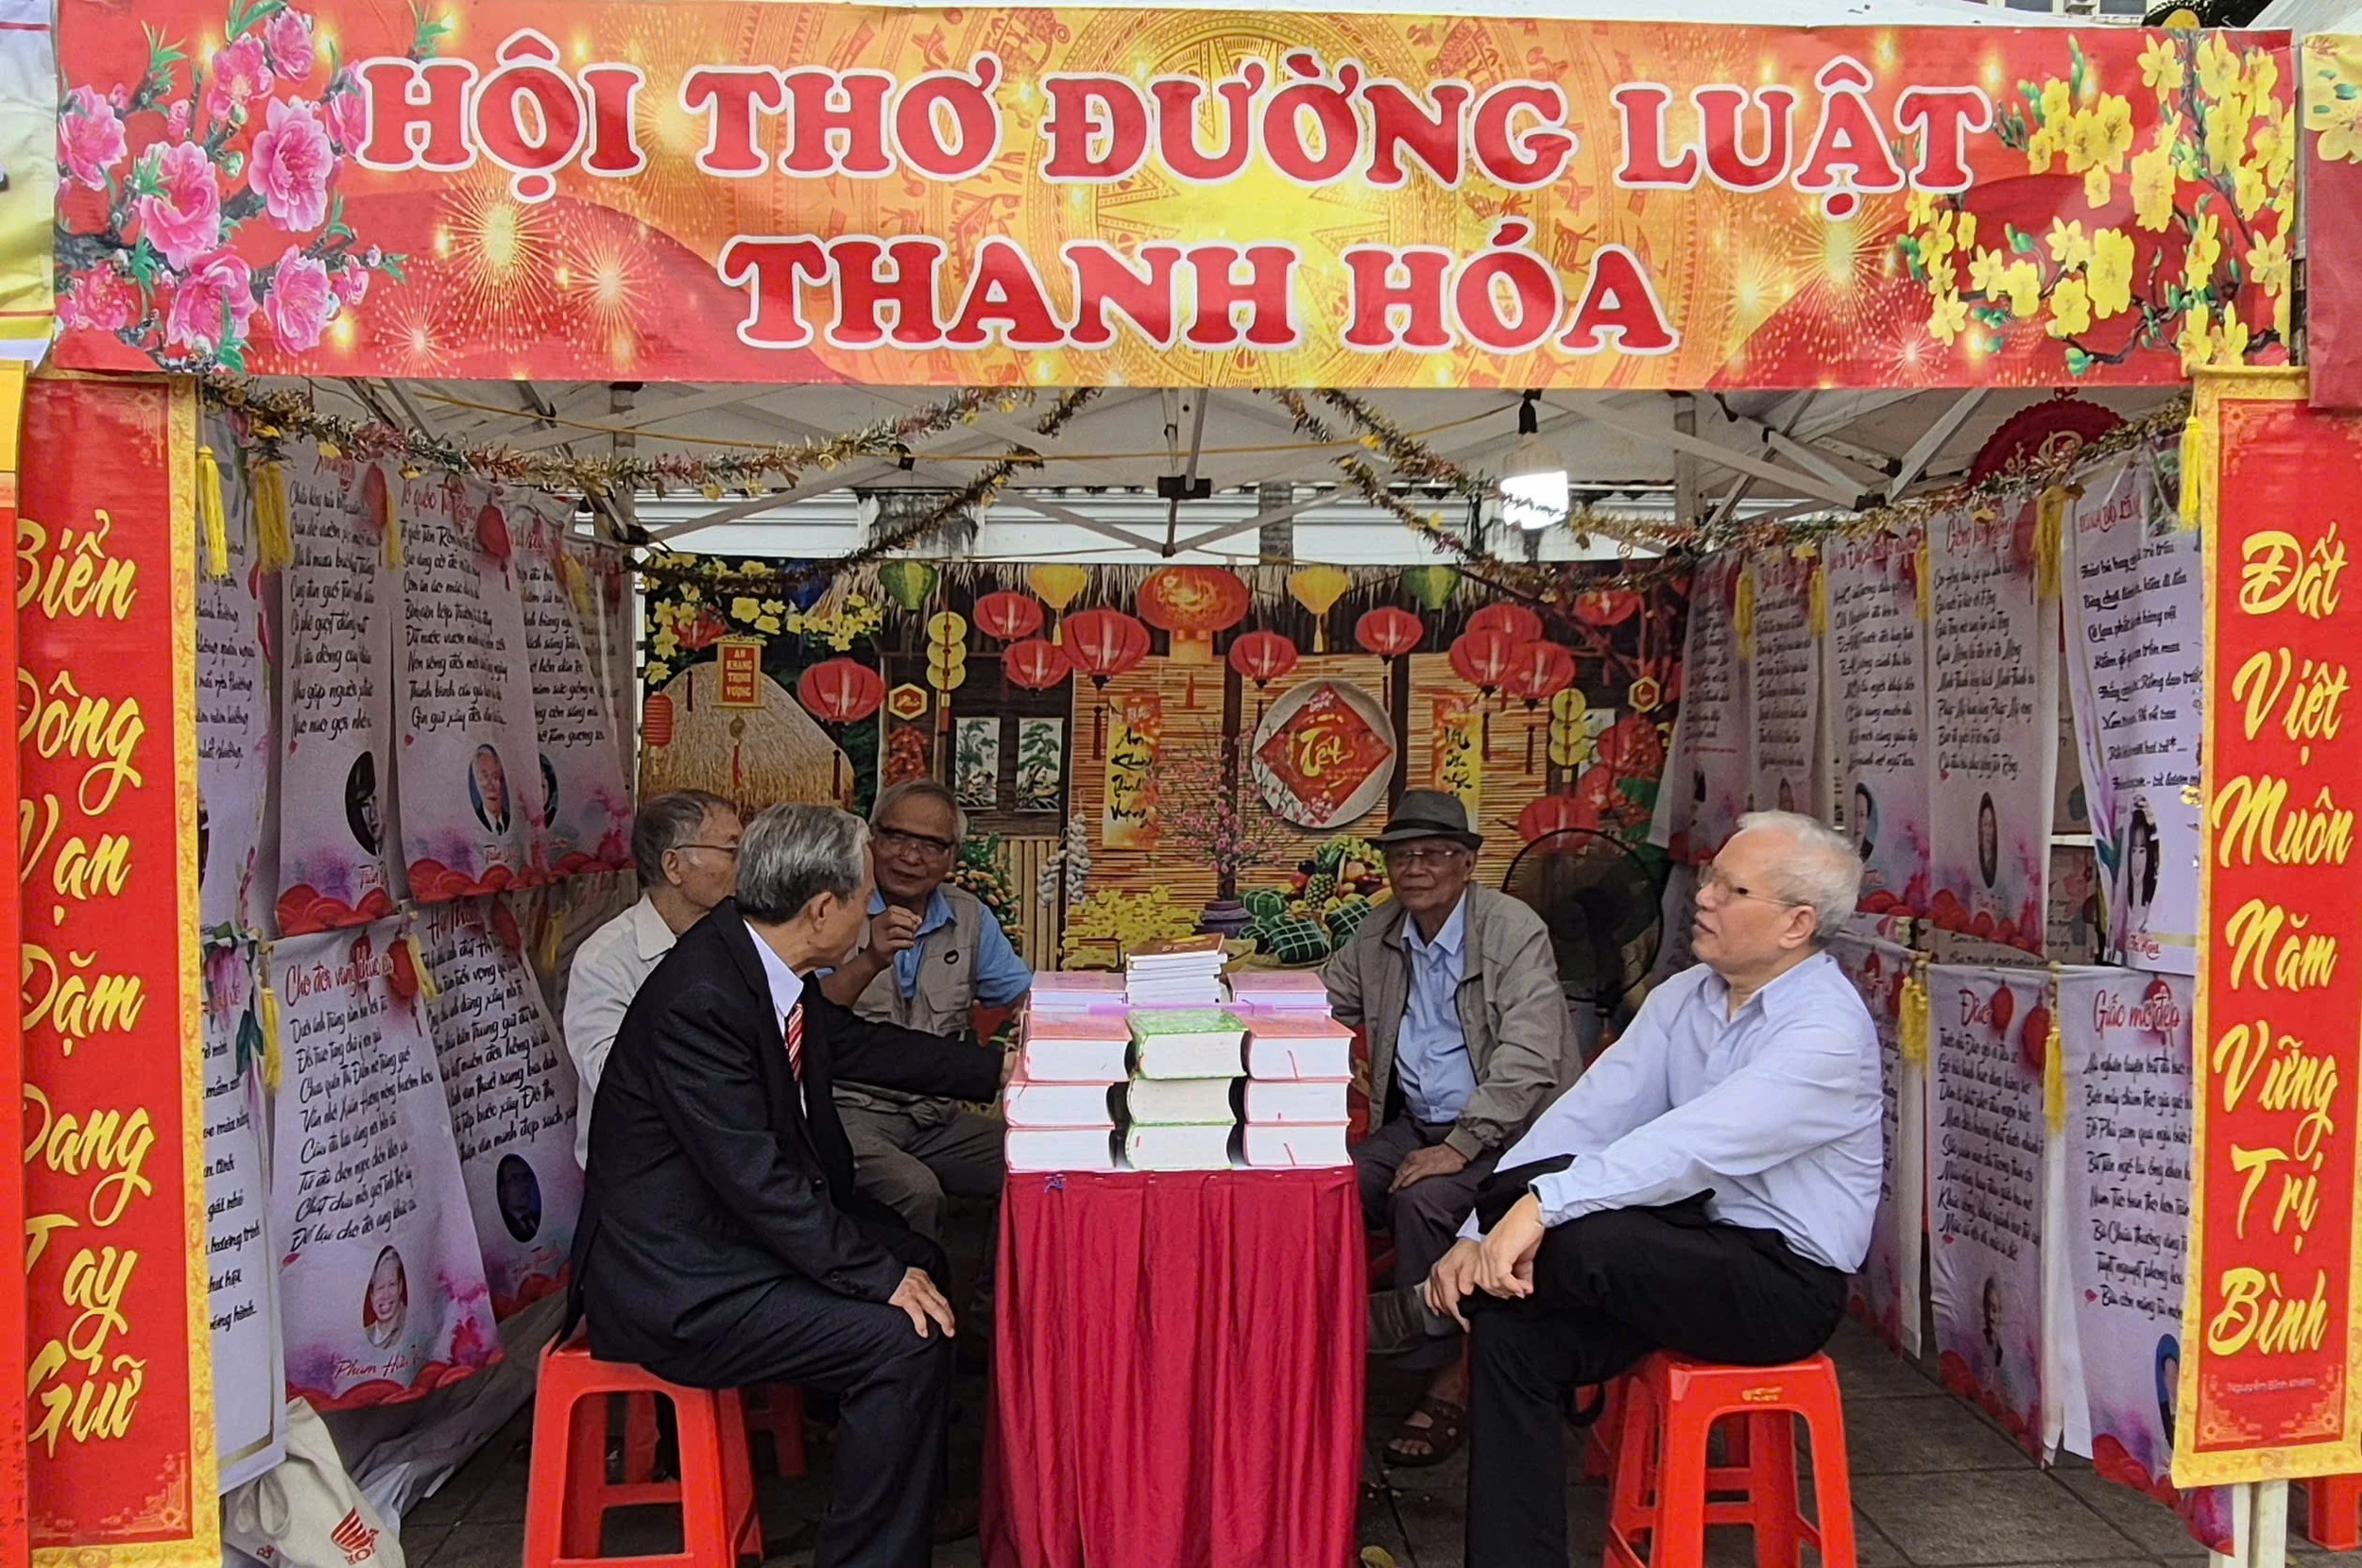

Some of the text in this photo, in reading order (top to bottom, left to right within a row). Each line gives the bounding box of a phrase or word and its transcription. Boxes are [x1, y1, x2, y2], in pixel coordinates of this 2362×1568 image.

[357, 27, 1994, 220] HỘI THƠ ĐƯỜNG LUẬT
[717, 216, 1682, 357] THANH HÓA
[2238, 521, 2349, 622] Đất
[2231, 645, 2351, 767] Việt
[2211, 773, 2355, 870] Muôn
[2223, 897, 2338, 992] Năm
[2094, 988, 2125, 1033] Giấc
[2212, 1019, 2339, 1161] Vững
[2231, 1143, 2323, 1256] Trị
[2207, 1266, 2328, 1356] Bình
